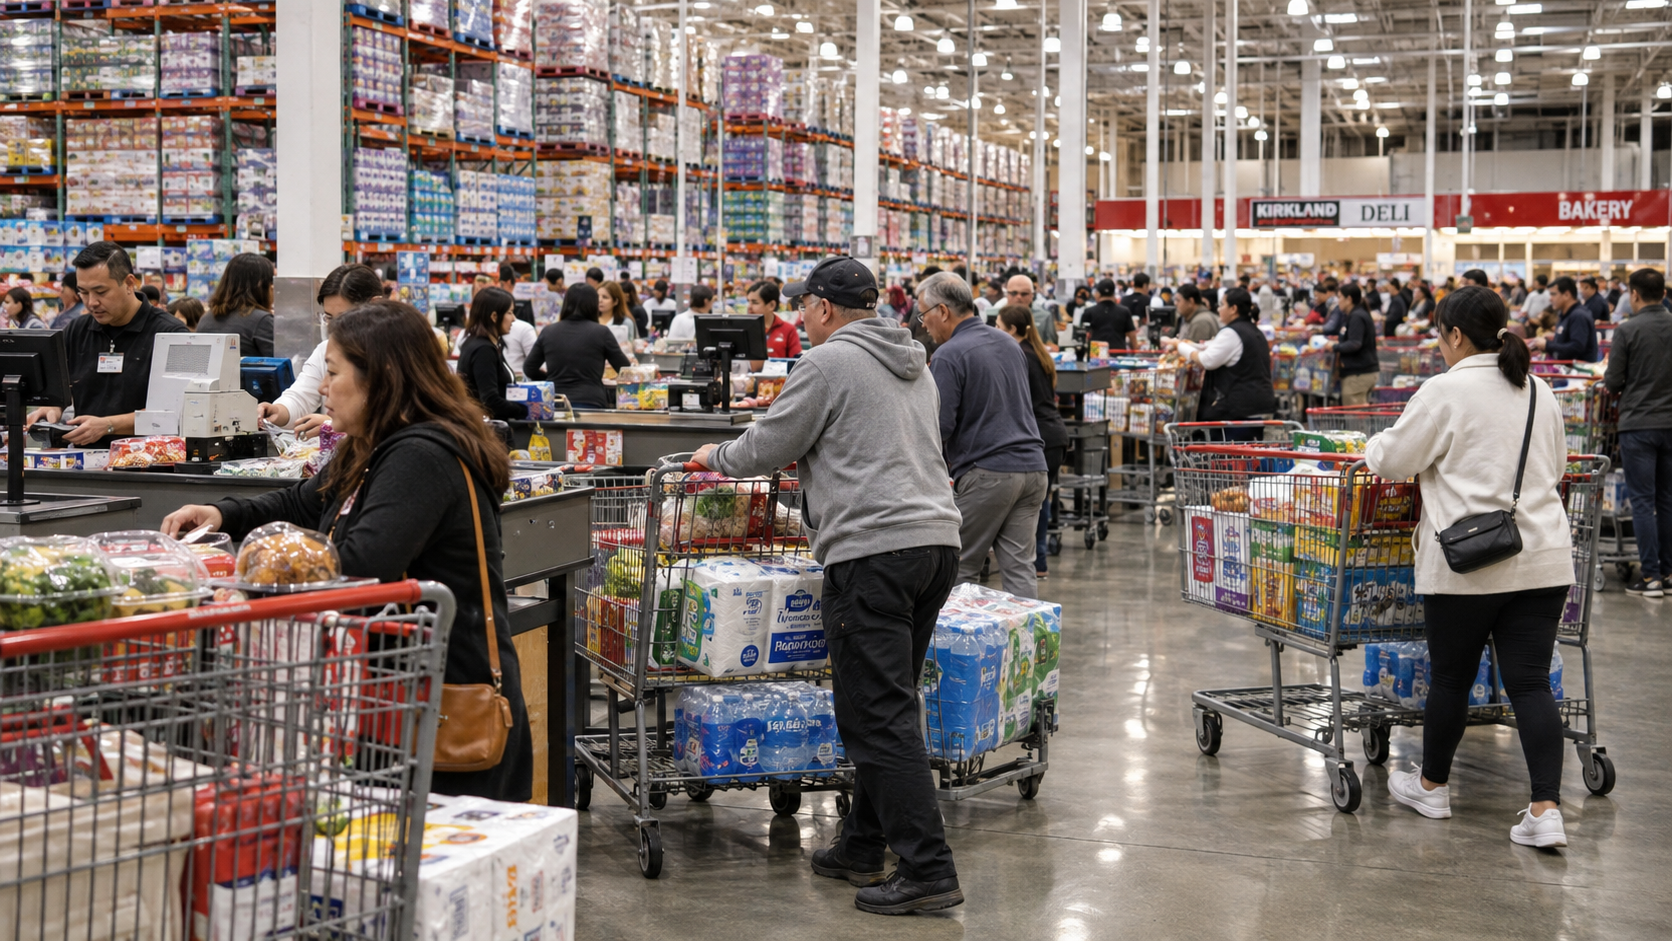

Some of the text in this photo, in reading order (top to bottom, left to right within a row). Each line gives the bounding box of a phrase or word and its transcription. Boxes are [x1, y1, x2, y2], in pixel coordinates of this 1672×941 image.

[1257, 203, 1337, 217] KIRKLAND
[1361, 204, 1410, 221] DELI
[1558, 200, 1633, 219] BAKERY
